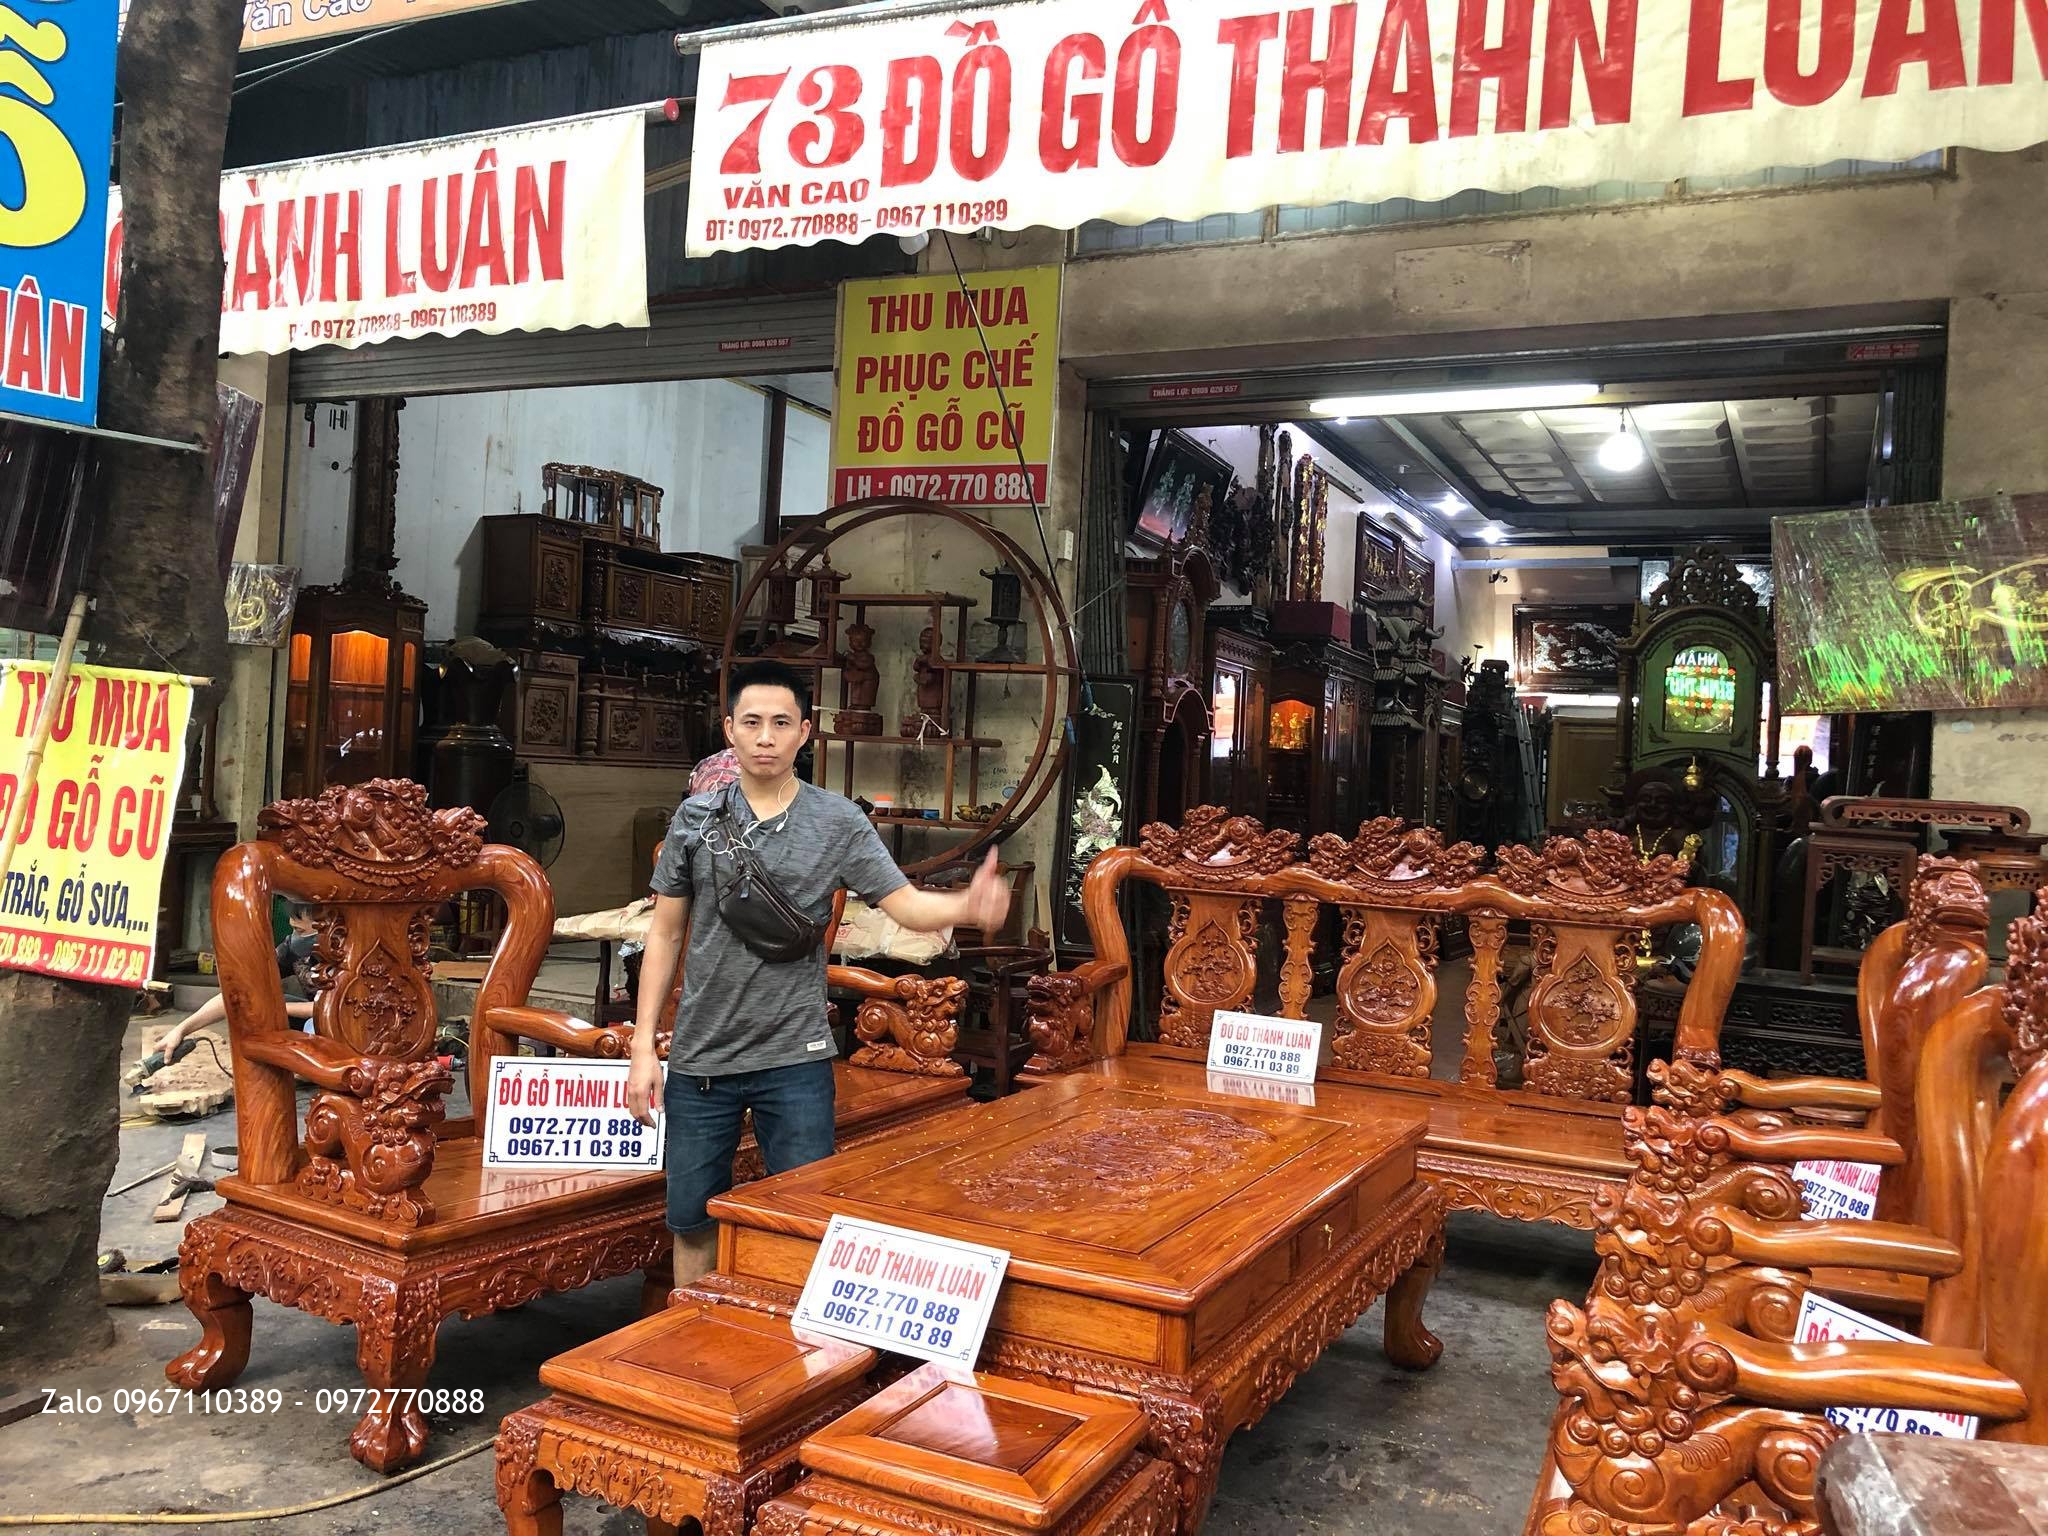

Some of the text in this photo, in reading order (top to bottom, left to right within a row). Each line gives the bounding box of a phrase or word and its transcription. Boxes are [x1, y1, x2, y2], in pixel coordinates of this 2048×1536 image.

[718, 64, 864, 175] 73
[723, 178, 870, 210] VĂN CAO
[386, 147, 566, 297] LUÂN
[868, 285, 1029, 334] THU MUA
[856, 332, 1039, 402] PHỤC CHẾ
[857, 396, 1025, 454] ĐỒ GỖ CŨ
[994, 472, 1035, 500] 888
[88, 677, 170, 752] MUA
[47, 754, 104, 853] GỖ
[108, 774, 165, 860] CŨ
[56, 865, 87, 923] GỖ
[1223, 1055, 1300, 1075] 0967.11 03 89
[1225, 1043, 1301, 1063] 0972.770 888
[499, 1069, 522, 1106] ĐỒ
[528, 1069, 550, 1106] GỖ
[555, 1074, 609, 1108] THÀNH
[507, 1138, 642, 1158] 0967.11 03 89
[509, 1117, 643, 1137] 0972.770 888
[1848, 1198, 1869, 1216] 888
[823, 1301, 953, 1348] 0967.11 03 89
[831, 1279, 960, 1326] 0972.770 888
